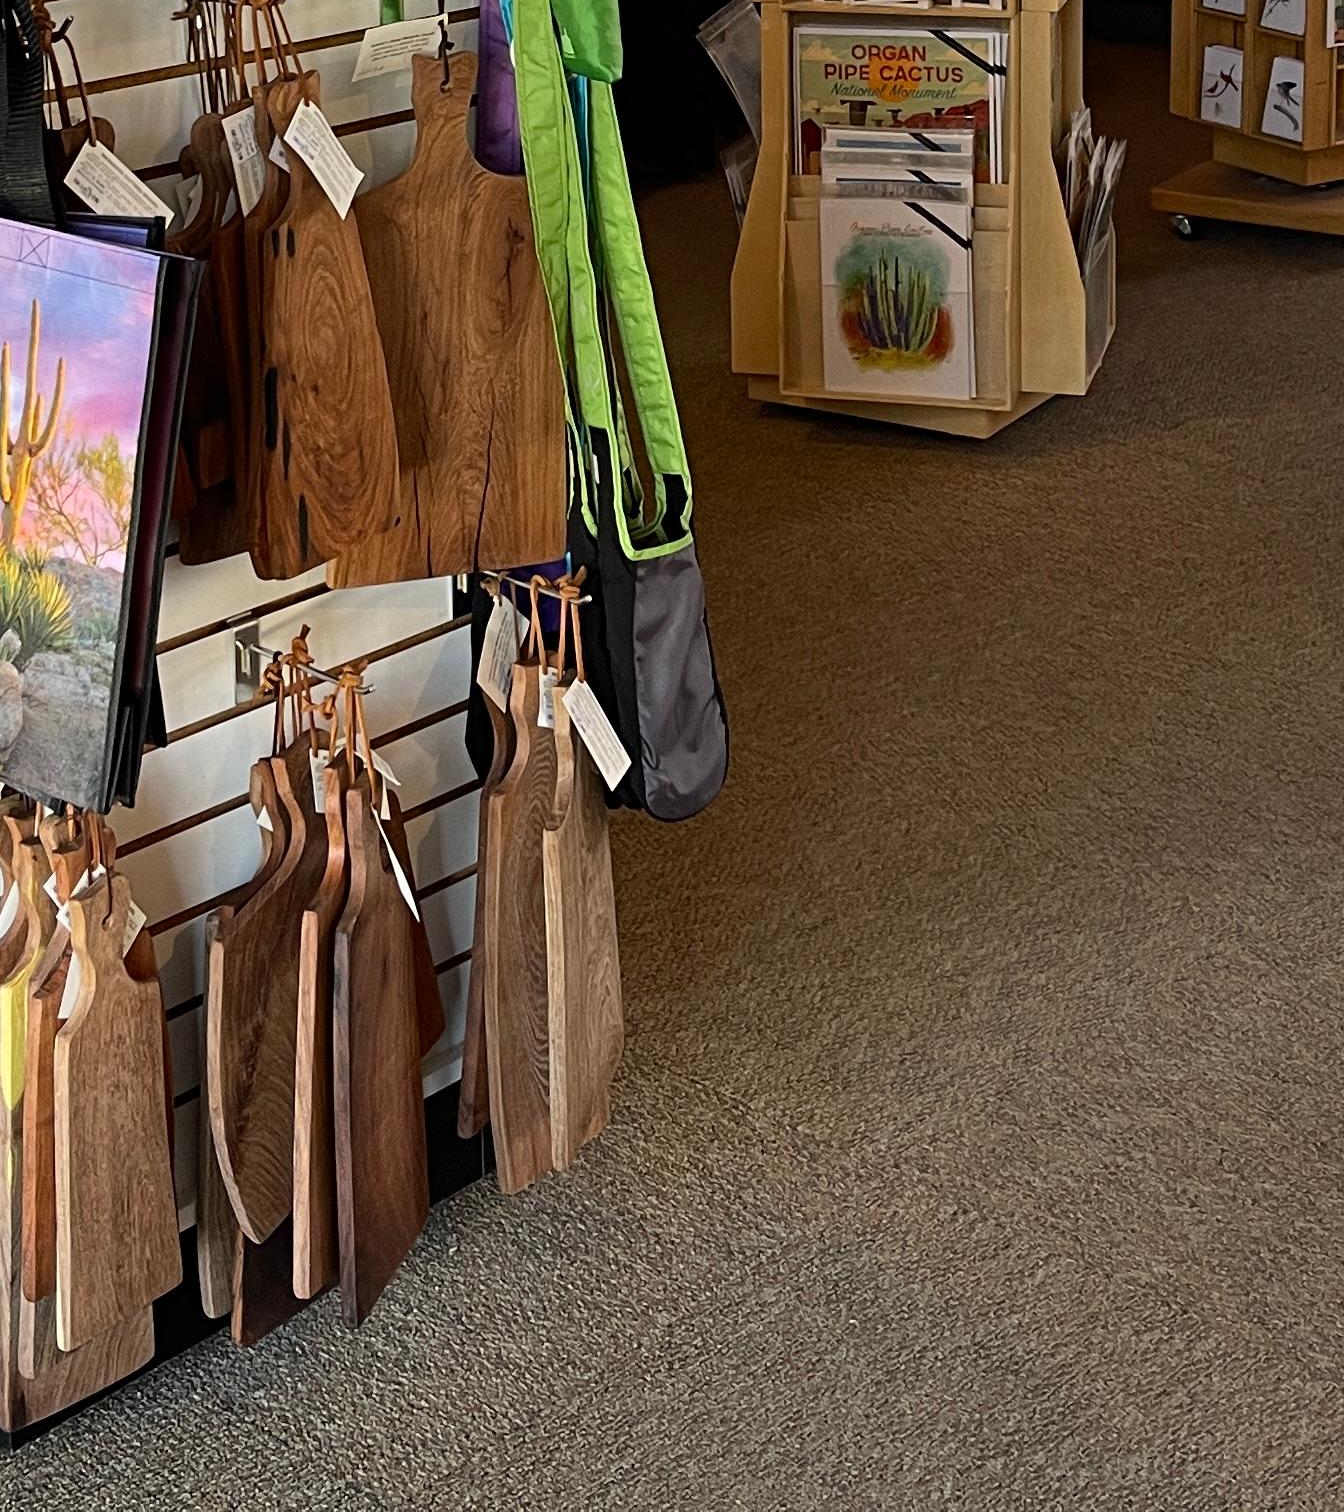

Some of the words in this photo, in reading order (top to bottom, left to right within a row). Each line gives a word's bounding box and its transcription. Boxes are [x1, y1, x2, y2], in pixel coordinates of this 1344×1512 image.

[851, 44, 926, 62] ORGAN
[824, 63, 870, 81] PIPE
[879, 65, 964, 83] CACTUS
[830, 83, 885, 98] National
[889, 85, 958, 100] Monument
